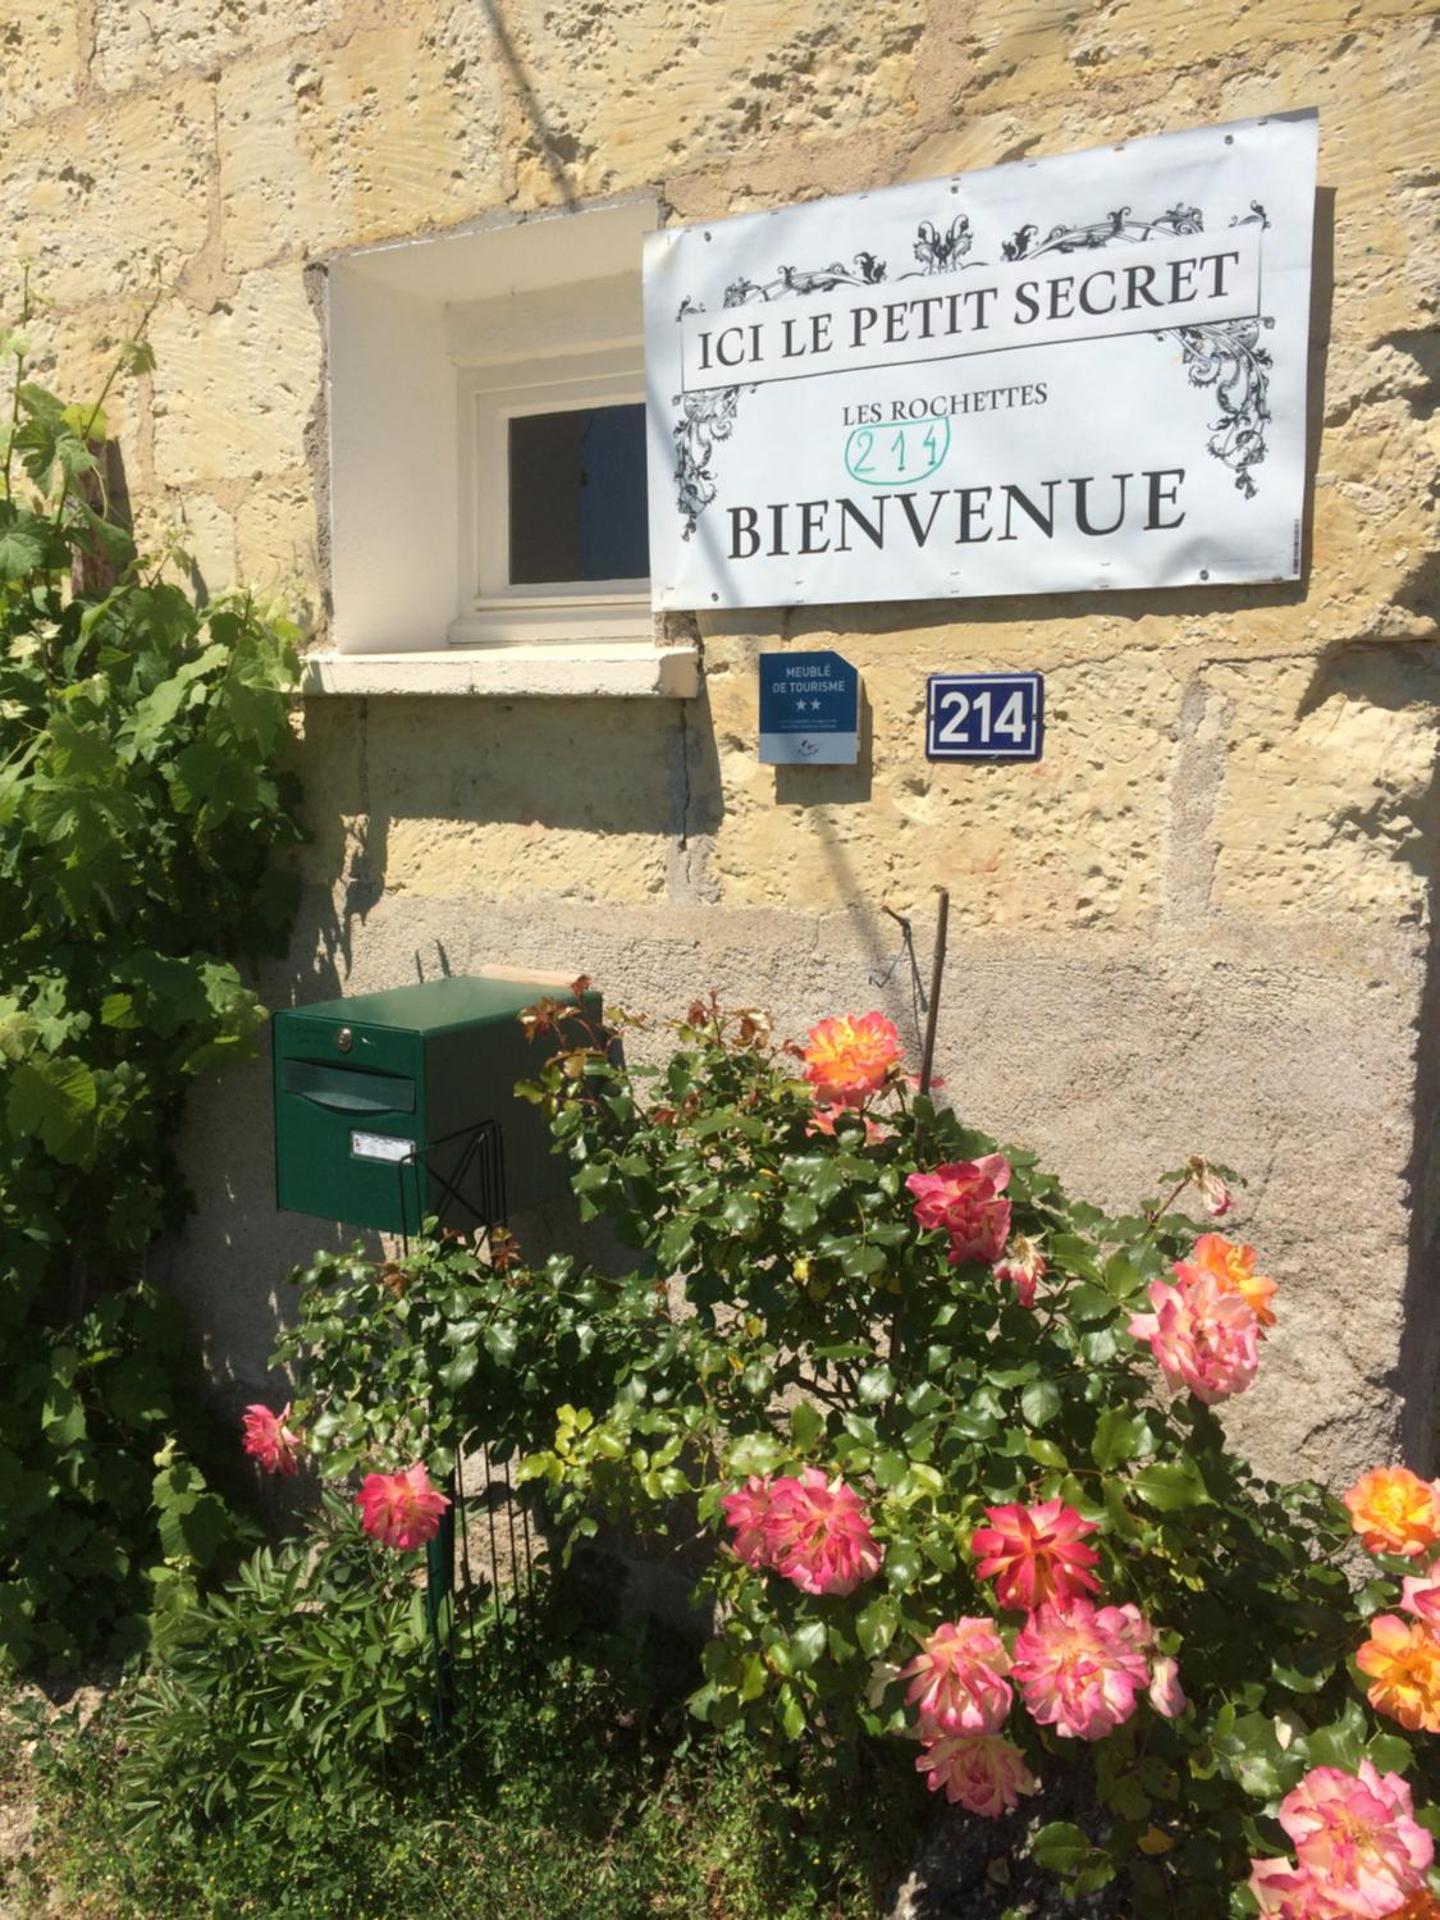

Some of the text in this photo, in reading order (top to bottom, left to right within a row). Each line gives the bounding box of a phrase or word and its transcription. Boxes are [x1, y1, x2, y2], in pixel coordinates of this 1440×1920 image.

[698, 251, 1240, 370] ICI LE PETIT SECRET
[843, 383, 1048, 426] LES ROCHETTES
[854, 425, 937, 472] 214
[728, 469, 1186, 559] BIENVENUE
[772, 680, 845, 693] DE TOURISME
[786, 665, 831, 678] MEUBLÉ
[939, 691, 1026, 743] 214
